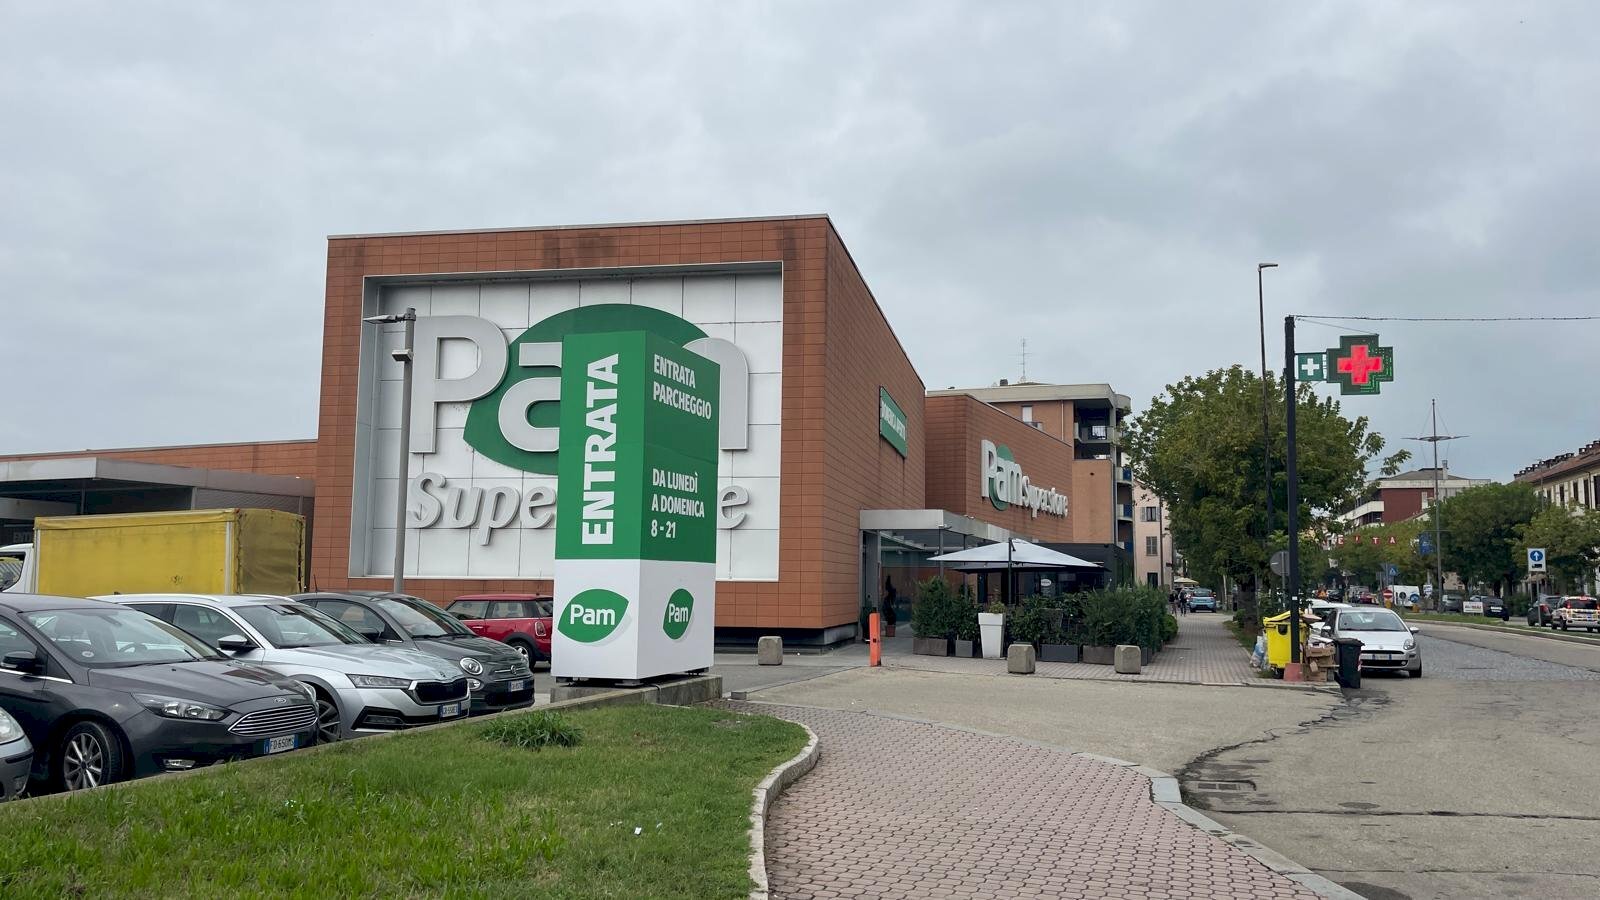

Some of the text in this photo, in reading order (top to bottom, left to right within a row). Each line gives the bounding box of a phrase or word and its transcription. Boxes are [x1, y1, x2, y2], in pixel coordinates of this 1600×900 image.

[653, 353, 696, 389] ENTRATA
[653, 381, 712, 420] PARCHEGGIO
[582, 353, 619, 545] ENTRATA
[652, 467, 698, 494] DA LUNEDÌ
[981, 439, 1022, 506] Pam
[651, 493, 705, 518] A DOMENICA
[651, 519, 658, 538] 8
[665, 520, 676, 539] 21
[570, 603, 616, 626] Pam
[668, 603, 689, 624] Pam
